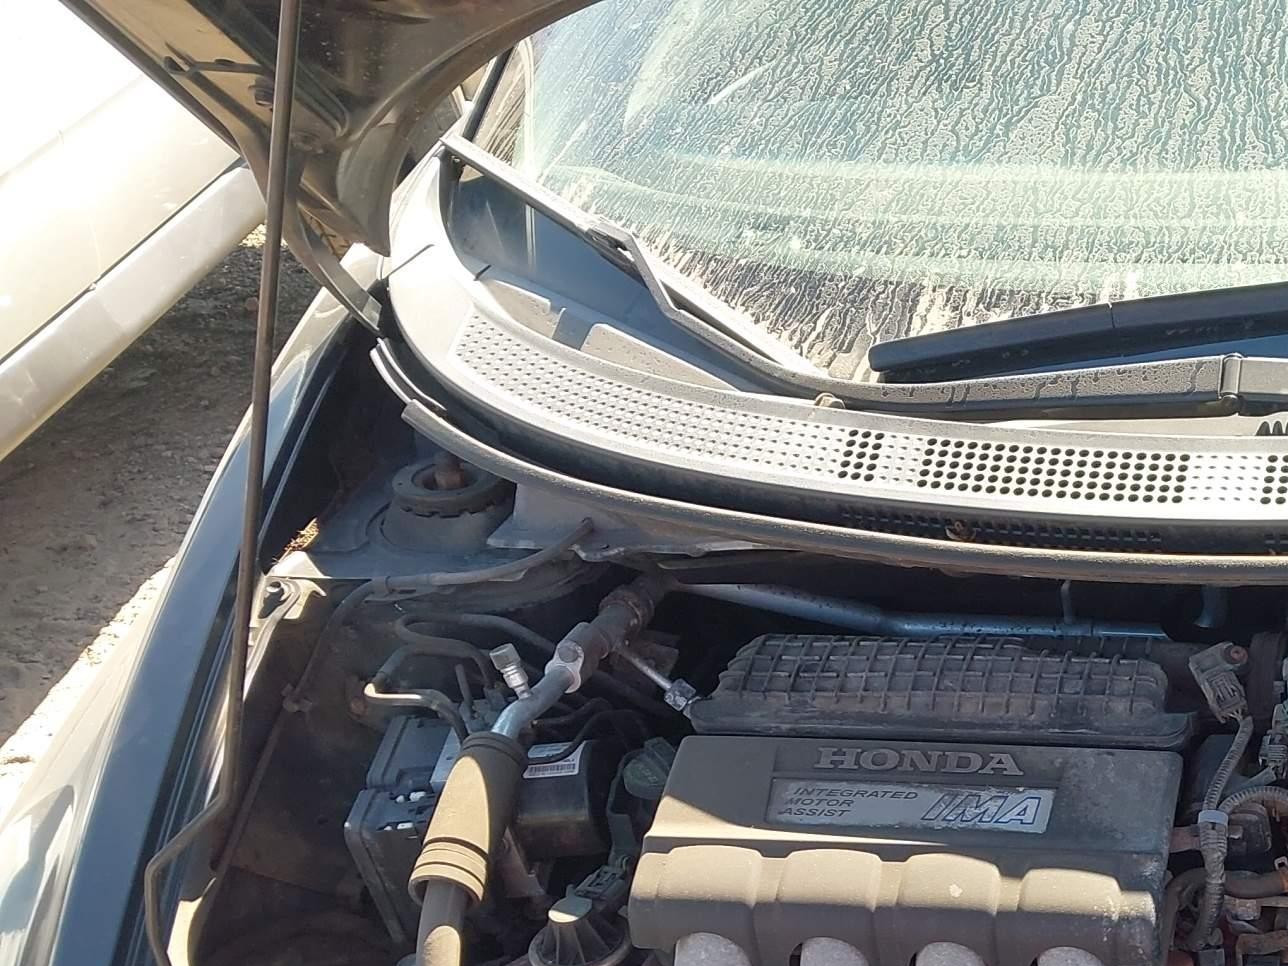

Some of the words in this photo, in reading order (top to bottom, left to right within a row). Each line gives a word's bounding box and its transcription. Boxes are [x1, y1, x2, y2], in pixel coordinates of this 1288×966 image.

[814, 747, 1024, 777] HONDA
[778, 807, 850, 818] ASSIST
[785, 797, 854, 808] MOTOR
[793, 787, 918, 800] INTEGRATED
[921, 793, 1042, 825] IMA
